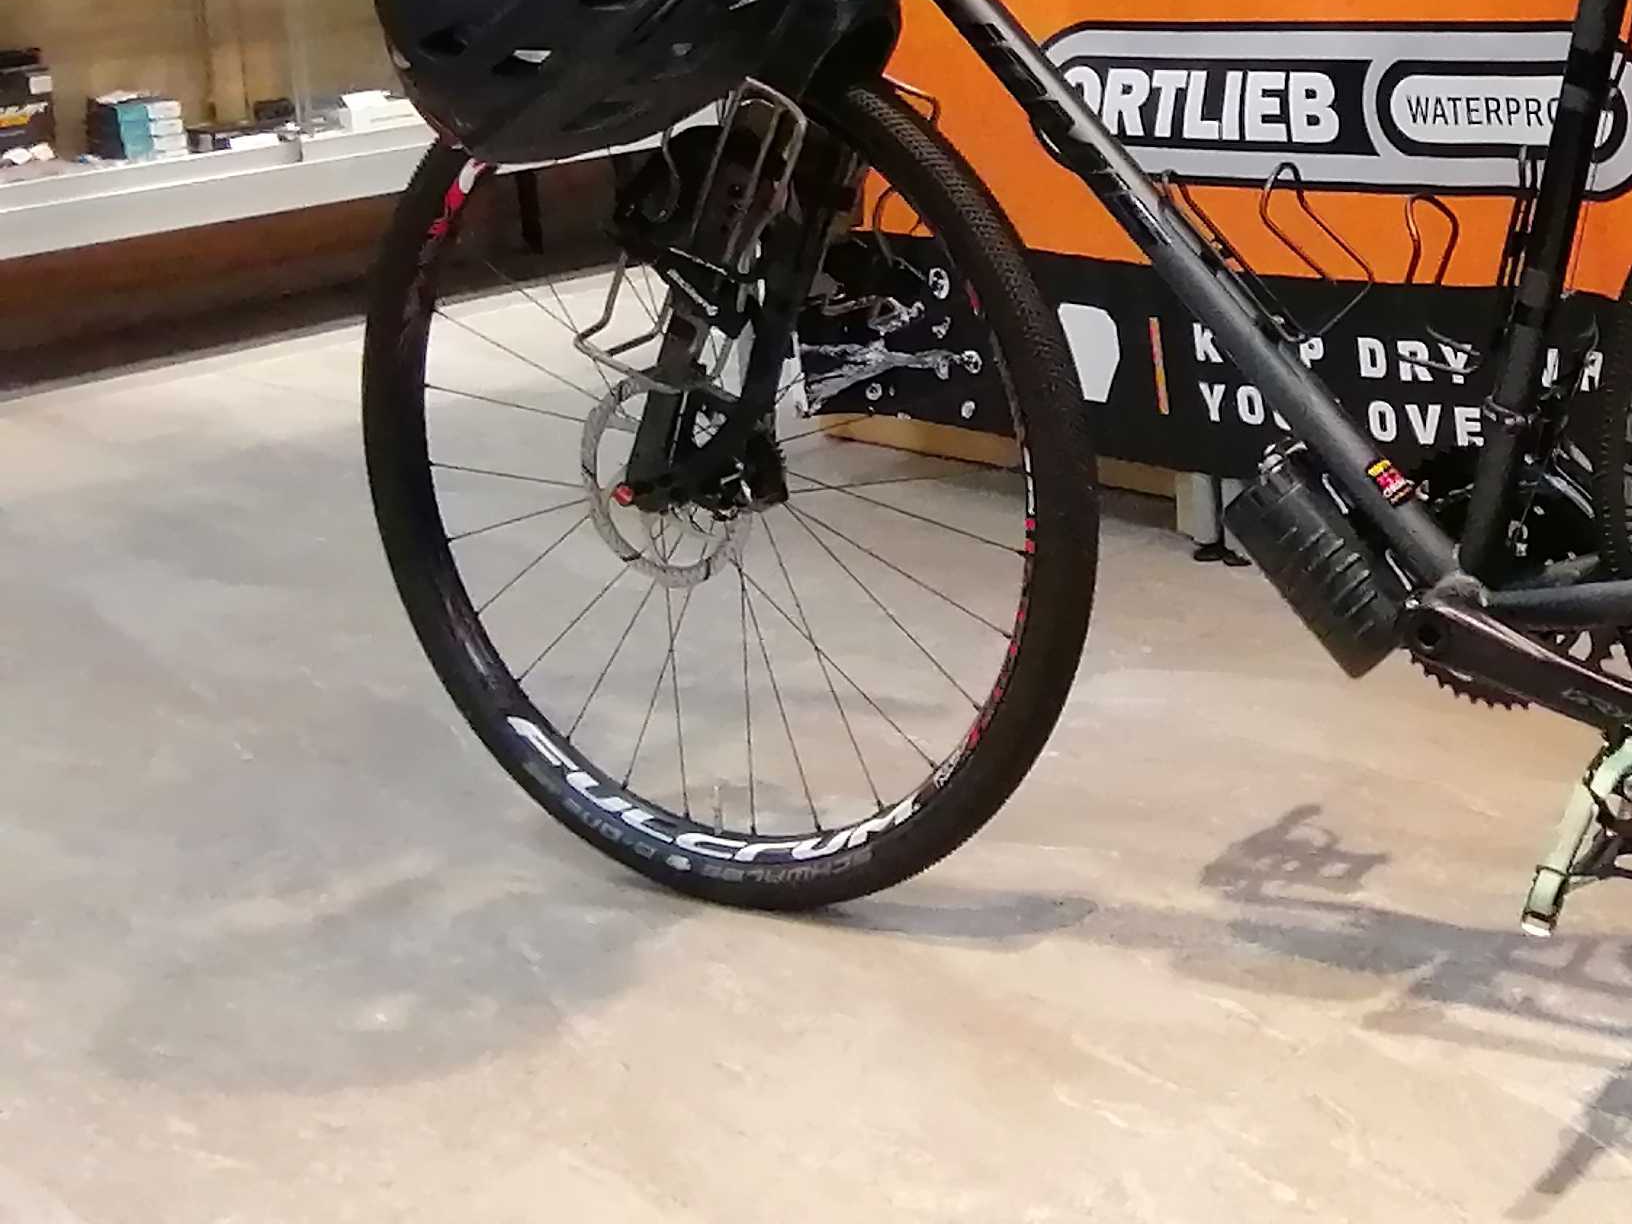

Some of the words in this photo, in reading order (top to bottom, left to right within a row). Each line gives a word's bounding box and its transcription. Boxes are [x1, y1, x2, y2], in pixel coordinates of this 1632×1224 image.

[1407, 95, 1560, 128] WATERPRO
[1192, 322, 1325, 369] KP
[1357, 336, 1473, 385] DRY
[1199, 381, 1292, 431] YO
[1368, 400, 1485, 447] OVE
